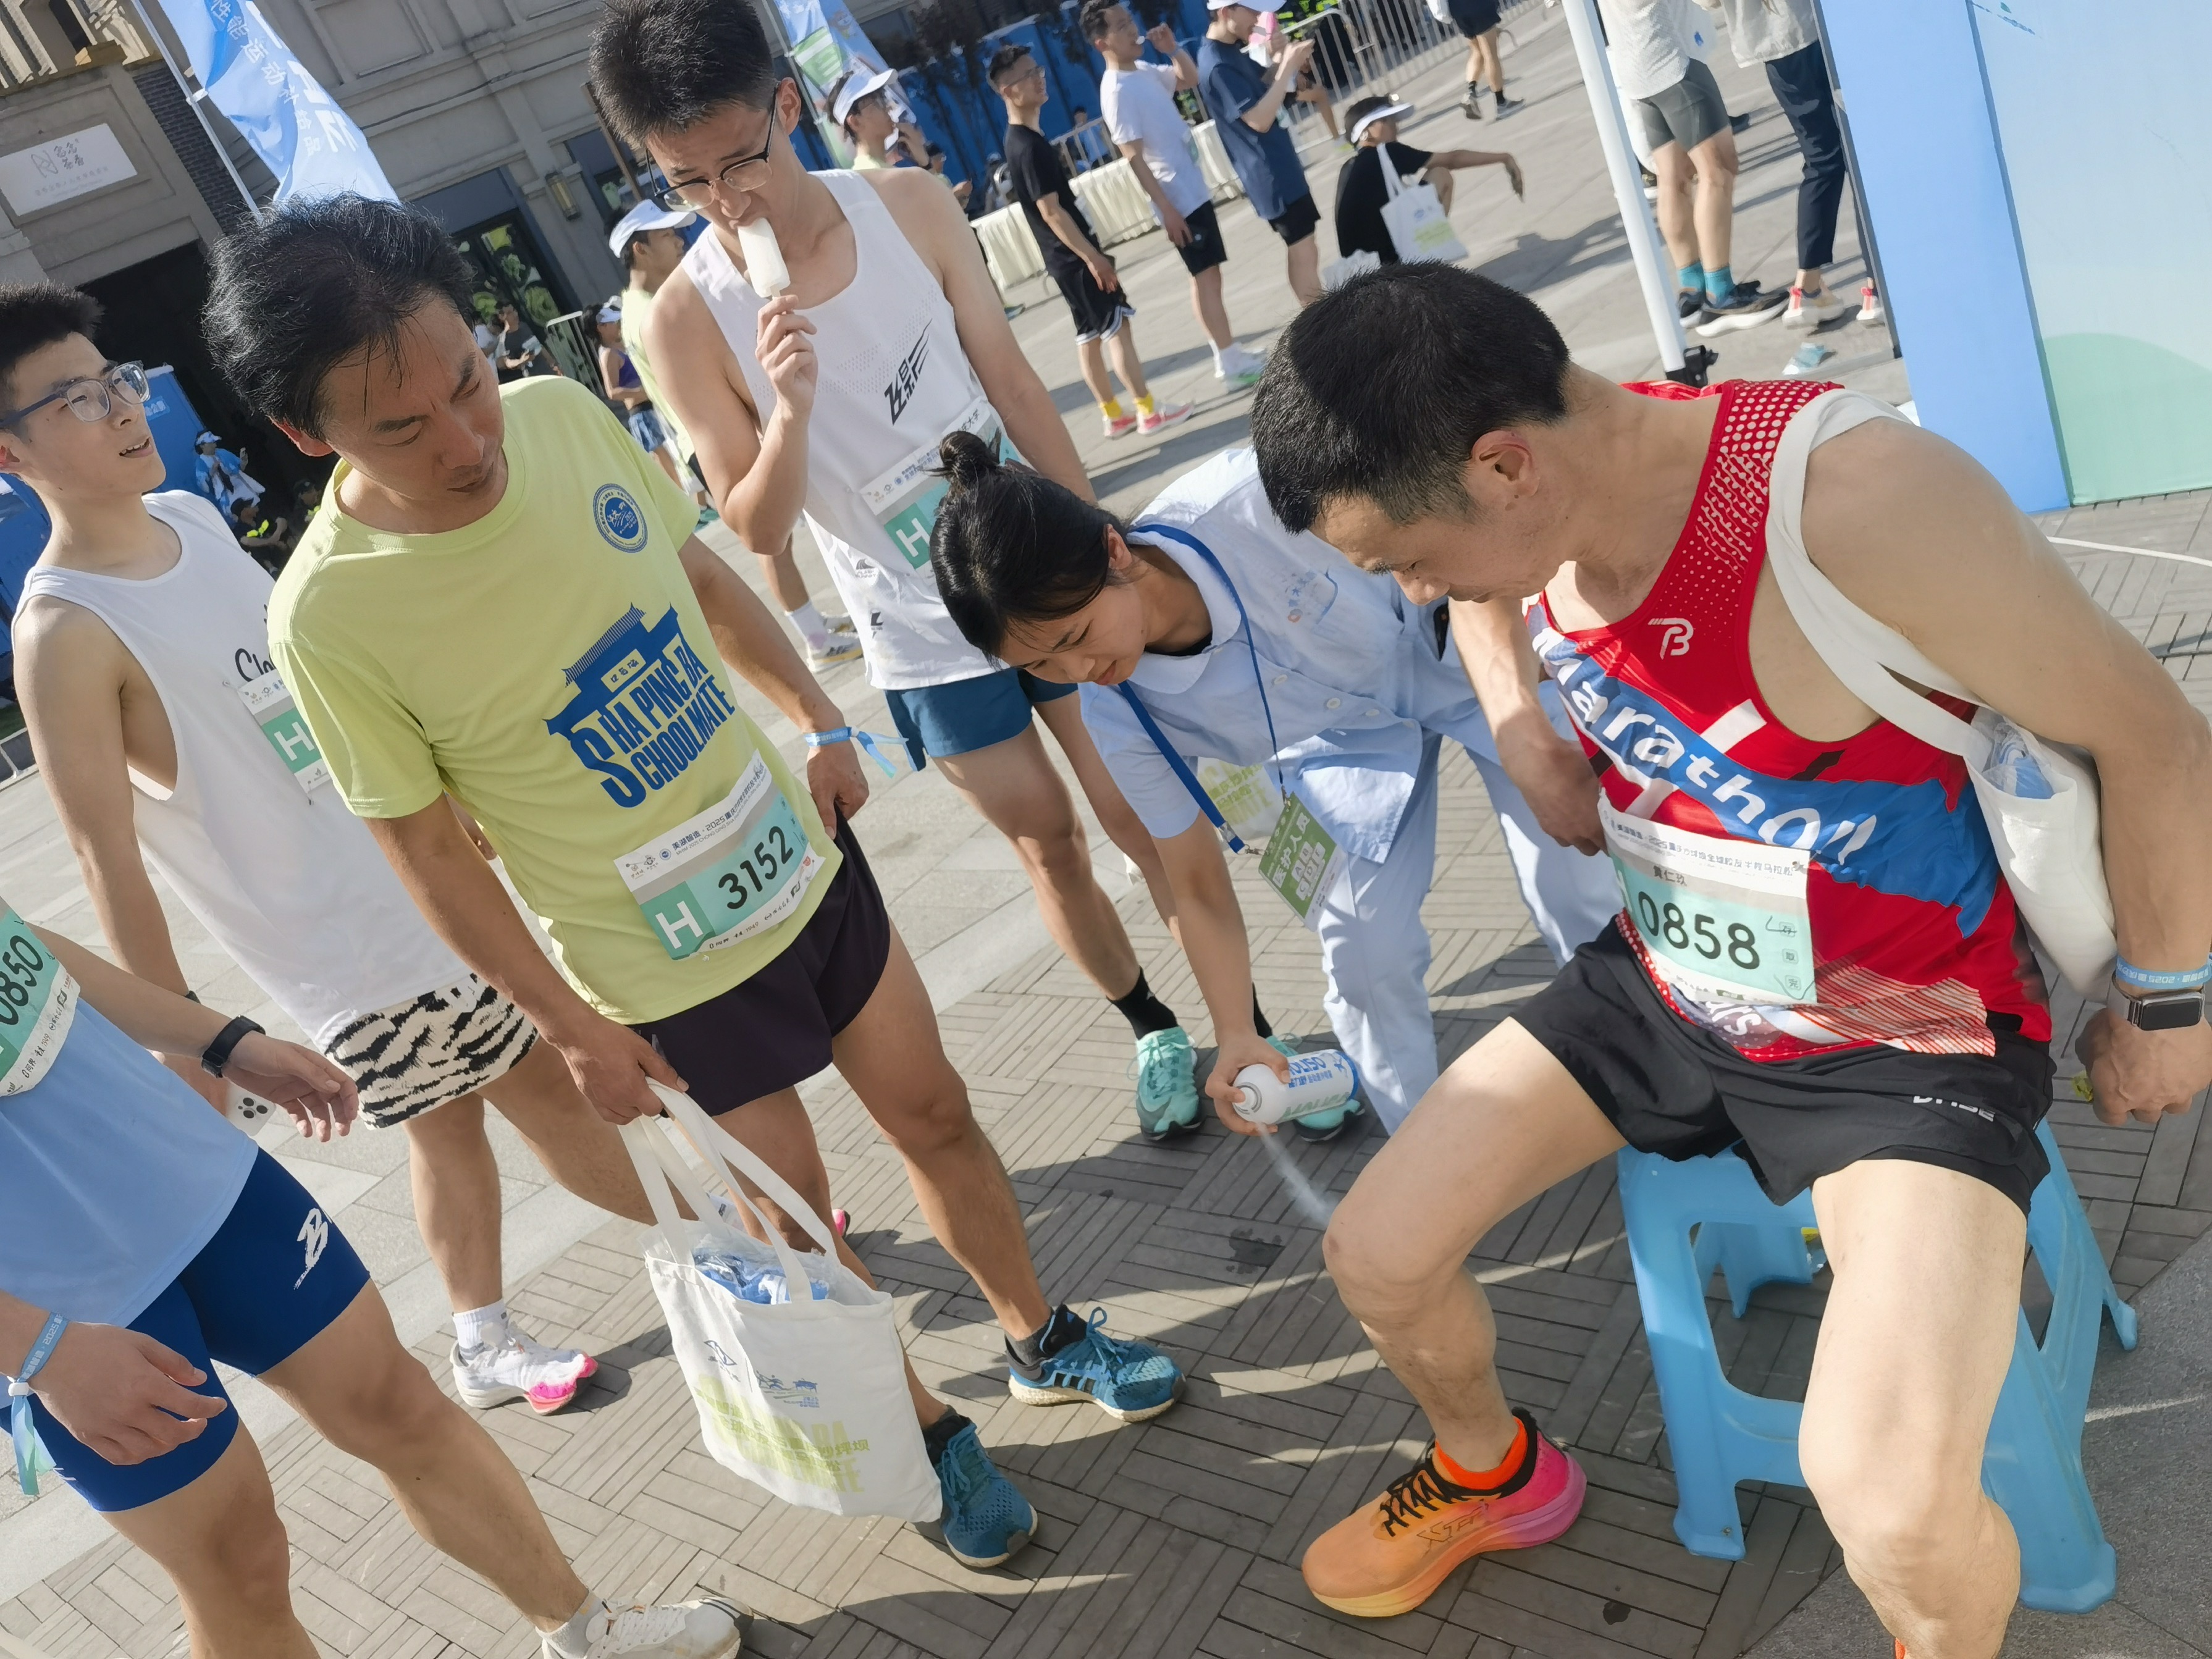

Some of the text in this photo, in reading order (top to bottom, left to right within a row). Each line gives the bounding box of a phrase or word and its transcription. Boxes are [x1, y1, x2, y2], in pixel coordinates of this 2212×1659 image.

[896, 518, 930, 557] H
[274, 721, 315, 762] H
[718, 826, 794, 909] 3152
[1272, 812, 1310, 888] 医护人员
[655, 901, 704, 949] H
[1638, 891, 1760, 970] 0858
